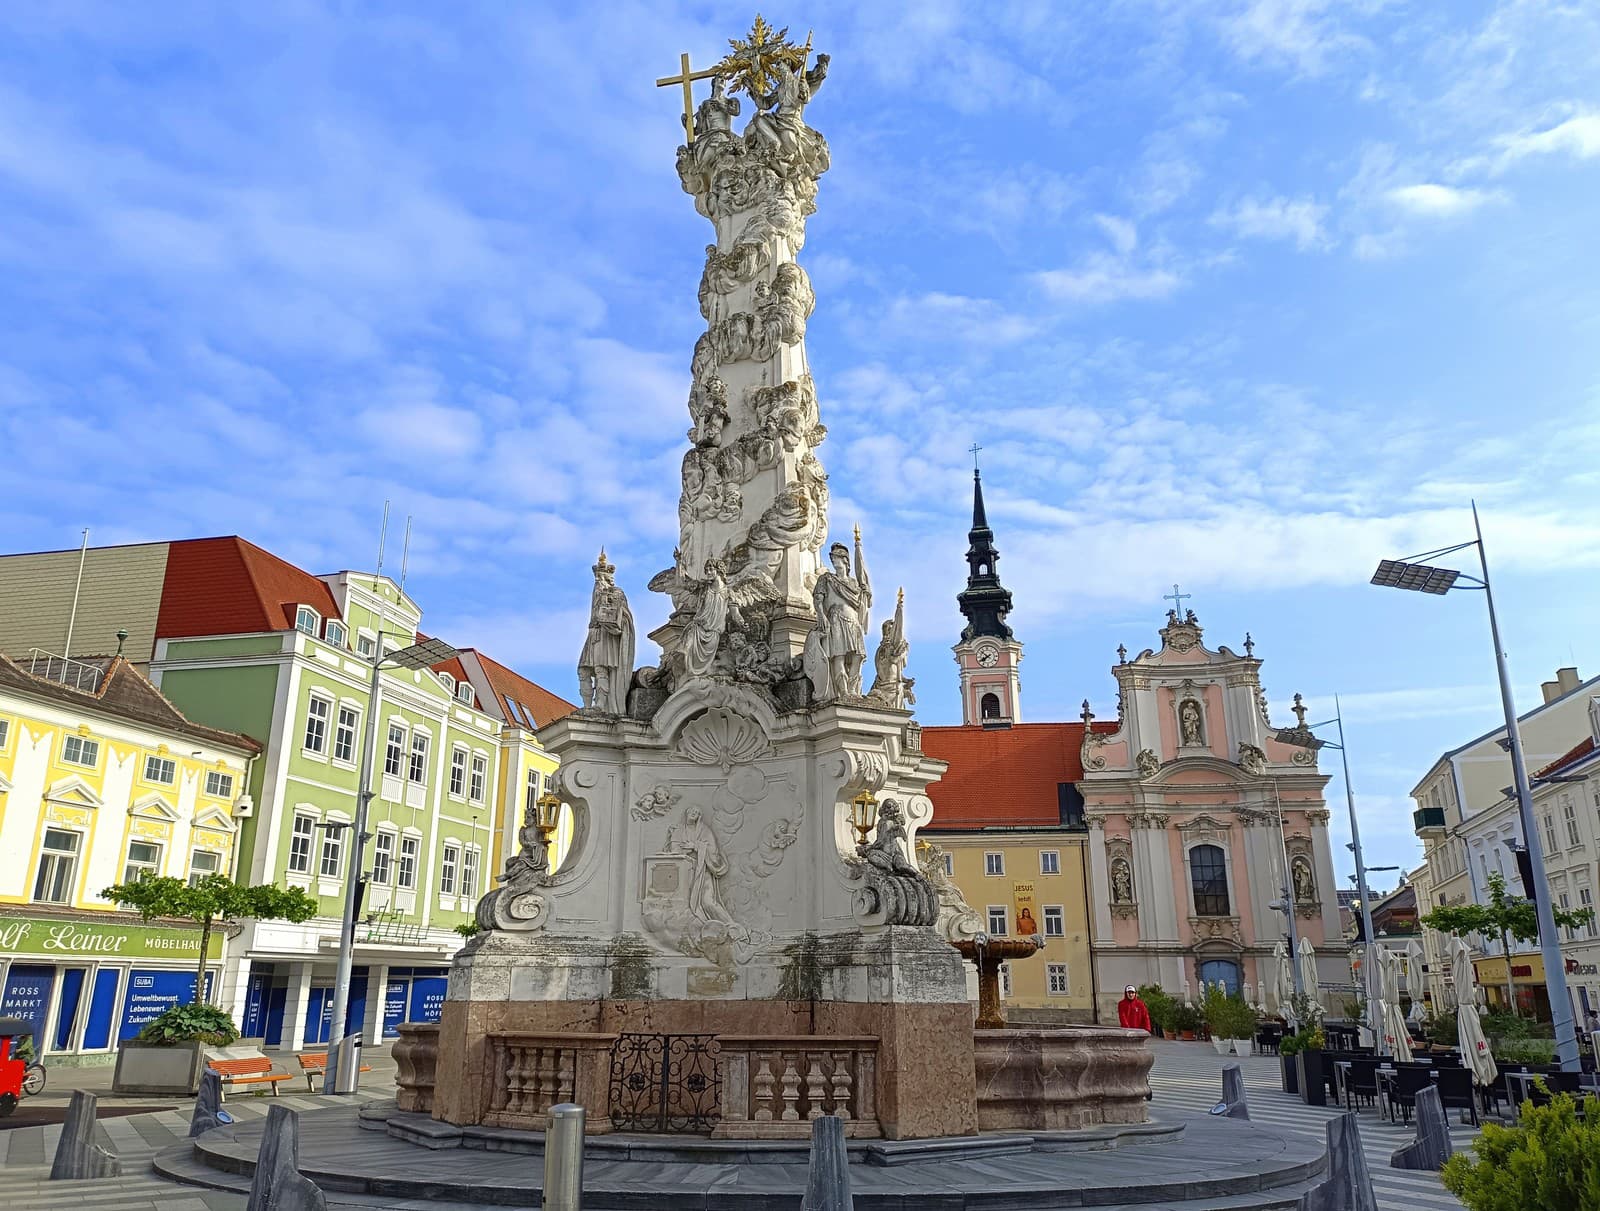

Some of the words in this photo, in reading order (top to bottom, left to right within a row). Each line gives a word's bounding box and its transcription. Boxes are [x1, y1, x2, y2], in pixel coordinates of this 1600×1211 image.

[43, 925, 127, 952] Leiner
[144, 935, 203, 950] MÖBELHAU
[11, 987, 40, 996] ROSS
[5, 999, 43, 1008] MARKT
[7, 1010, 36, 1020] HÖFE
